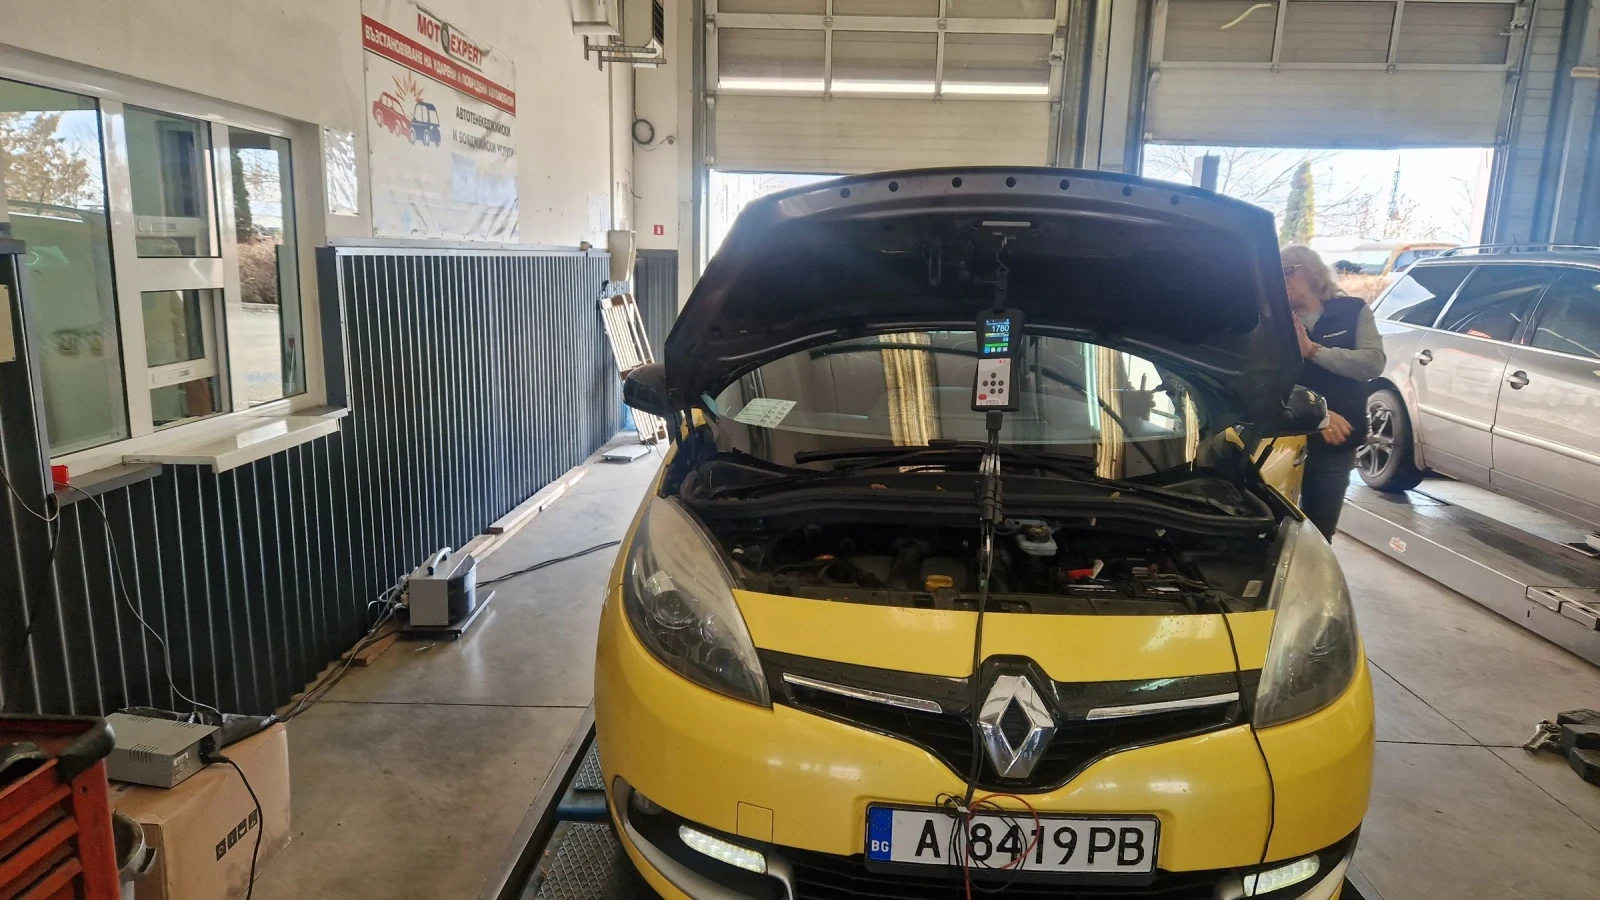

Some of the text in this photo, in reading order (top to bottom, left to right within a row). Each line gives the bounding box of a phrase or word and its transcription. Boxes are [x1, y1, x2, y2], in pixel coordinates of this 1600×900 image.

[365, 24, 423, 65] ВЪЗСТАНОВЯВАНЕ
[423, 53, 433, 69] НА
[450, 33, 483, 66] EXPERT
[452, 128, 458, 142] И
[991, 324, 1010, 333] 1780
[870, 839, 889, 853] BG
